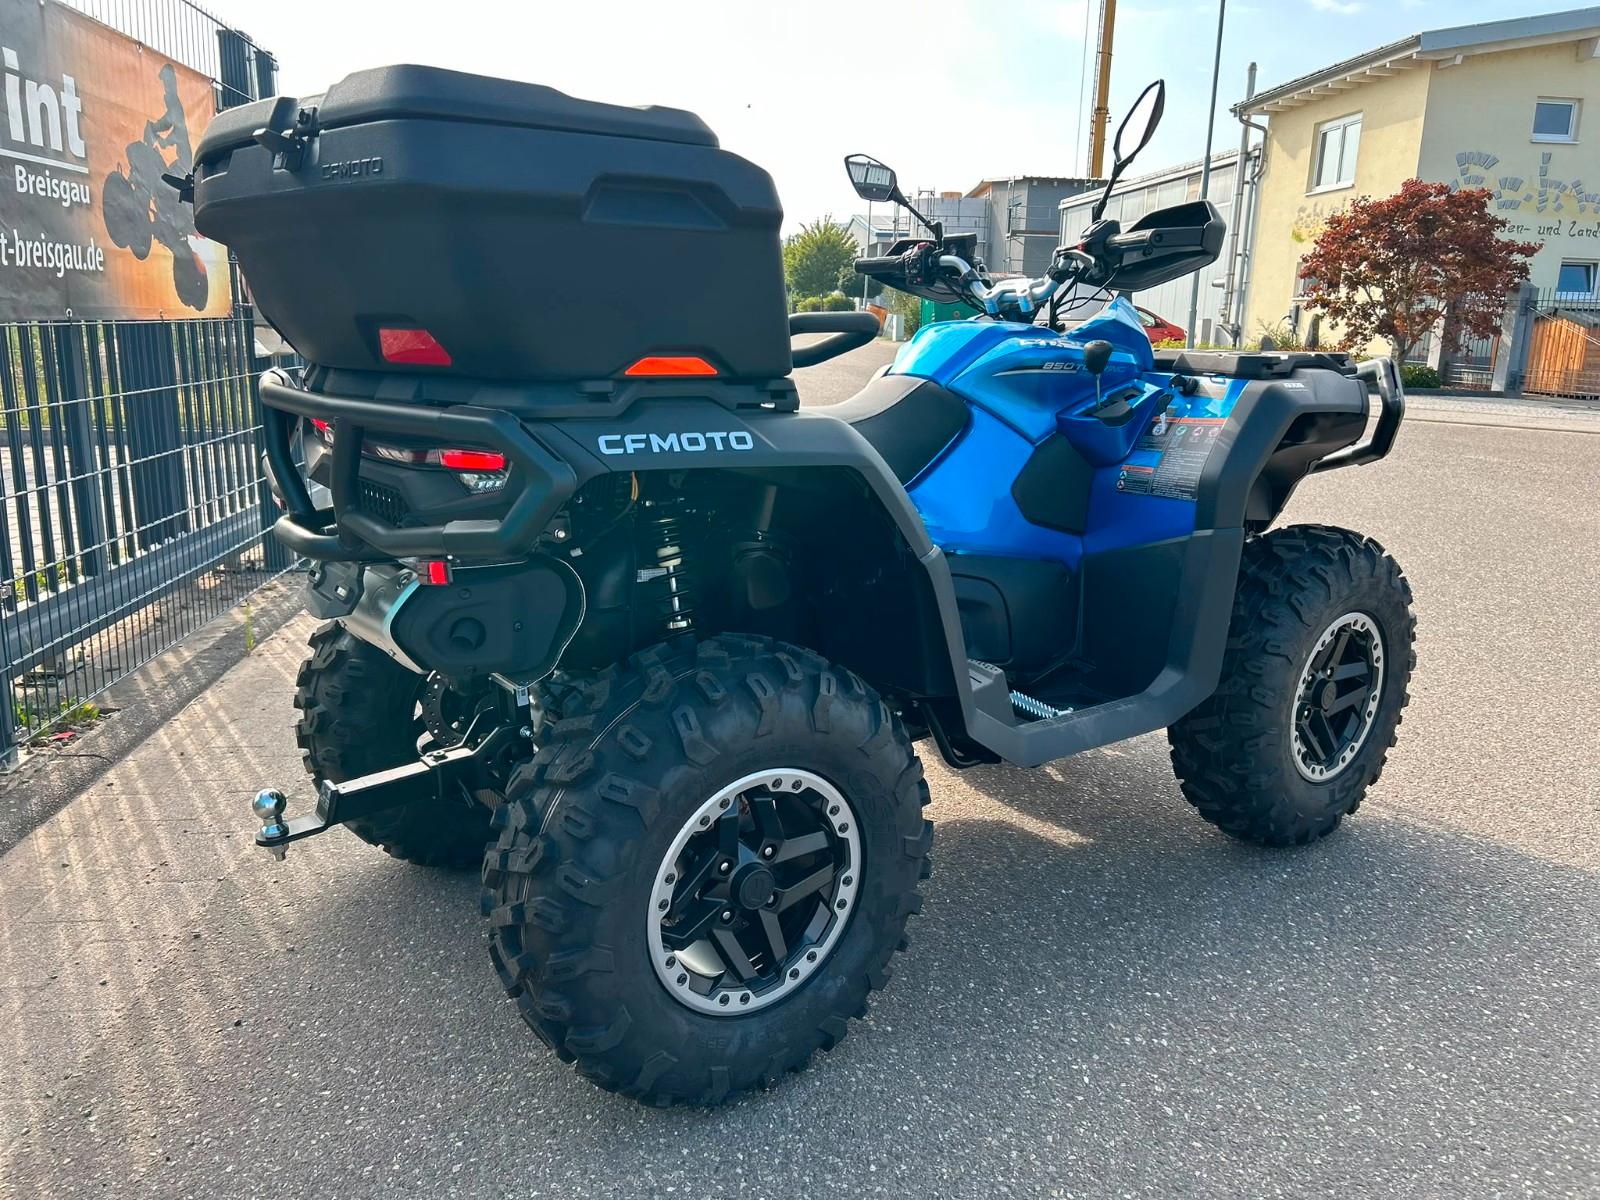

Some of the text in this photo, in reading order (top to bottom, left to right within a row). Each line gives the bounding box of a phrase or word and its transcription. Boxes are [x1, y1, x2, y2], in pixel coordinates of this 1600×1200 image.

[2, 46, 86, 158] int
[322, 157, 384, 180] CFMOTO
[15, 164, 91, 207] Breisgau
[1537, 219, 1562, 236] und
[0, 229, 104, 278] t-breisgau.de
[598, 431, 754, 455] CFMOTO
